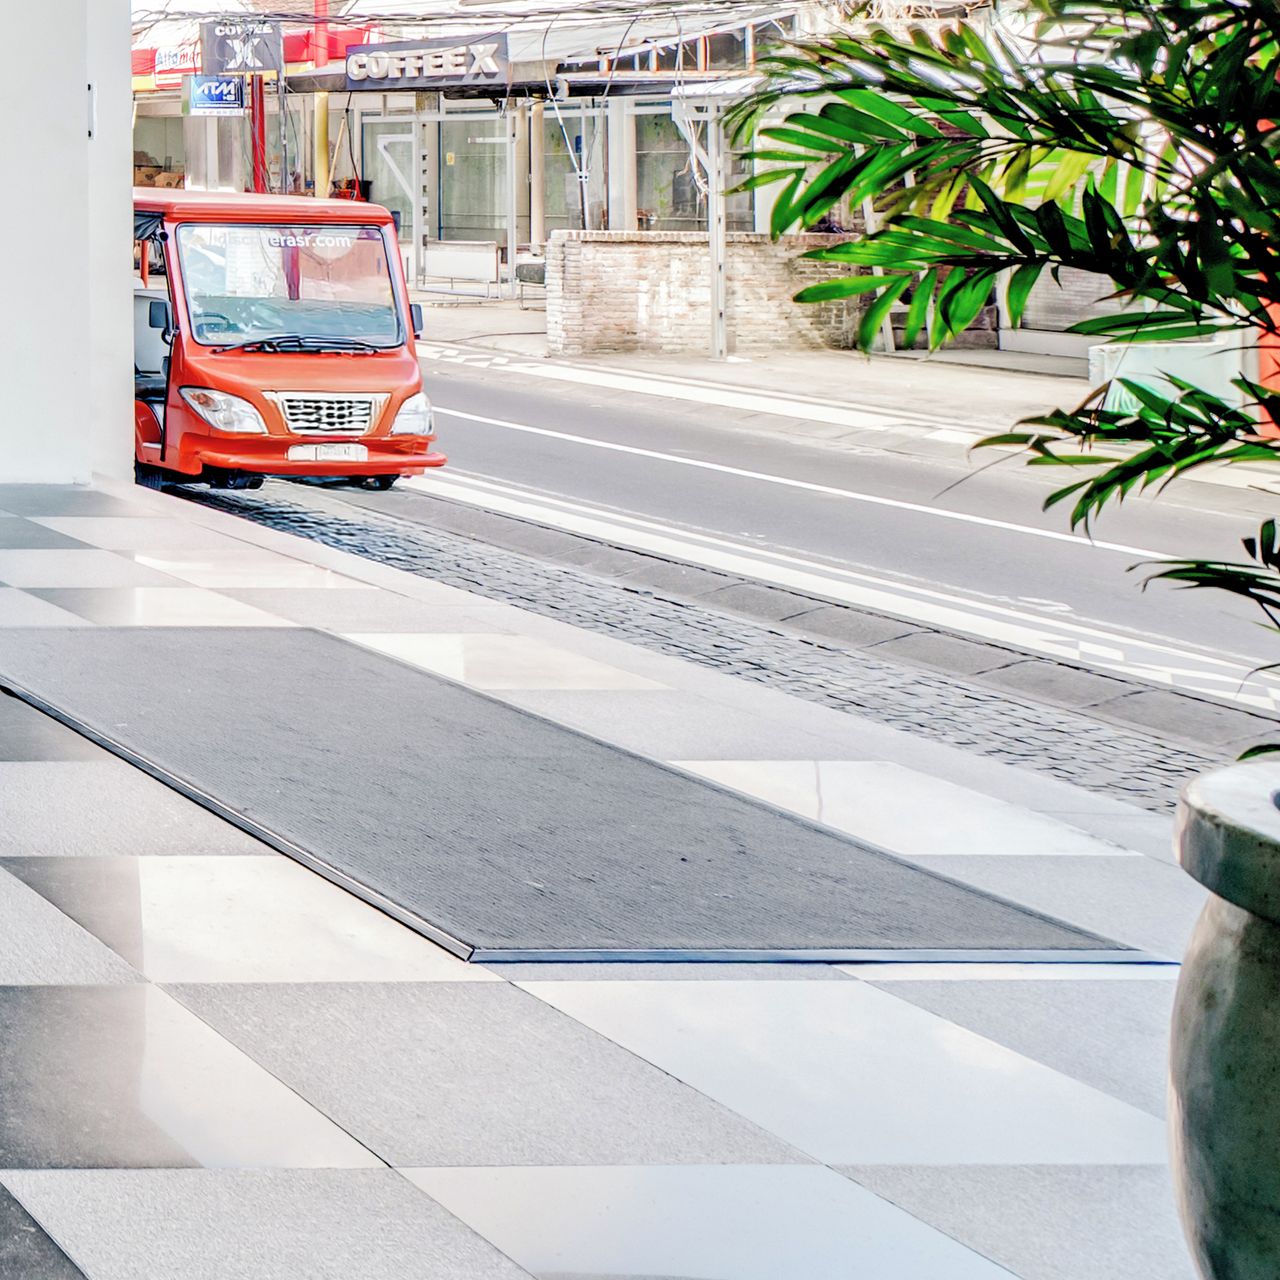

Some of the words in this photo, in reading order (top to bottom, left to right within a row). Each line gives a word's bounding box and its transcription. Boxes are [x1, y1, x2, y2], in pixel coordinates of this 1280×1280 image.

[156, 50, 200, 67] Alfamar
[346, 46, 468, 80] COFFEE
[468, 43, 500, 74] X
[268, 234, 352, 247] erasr.com
